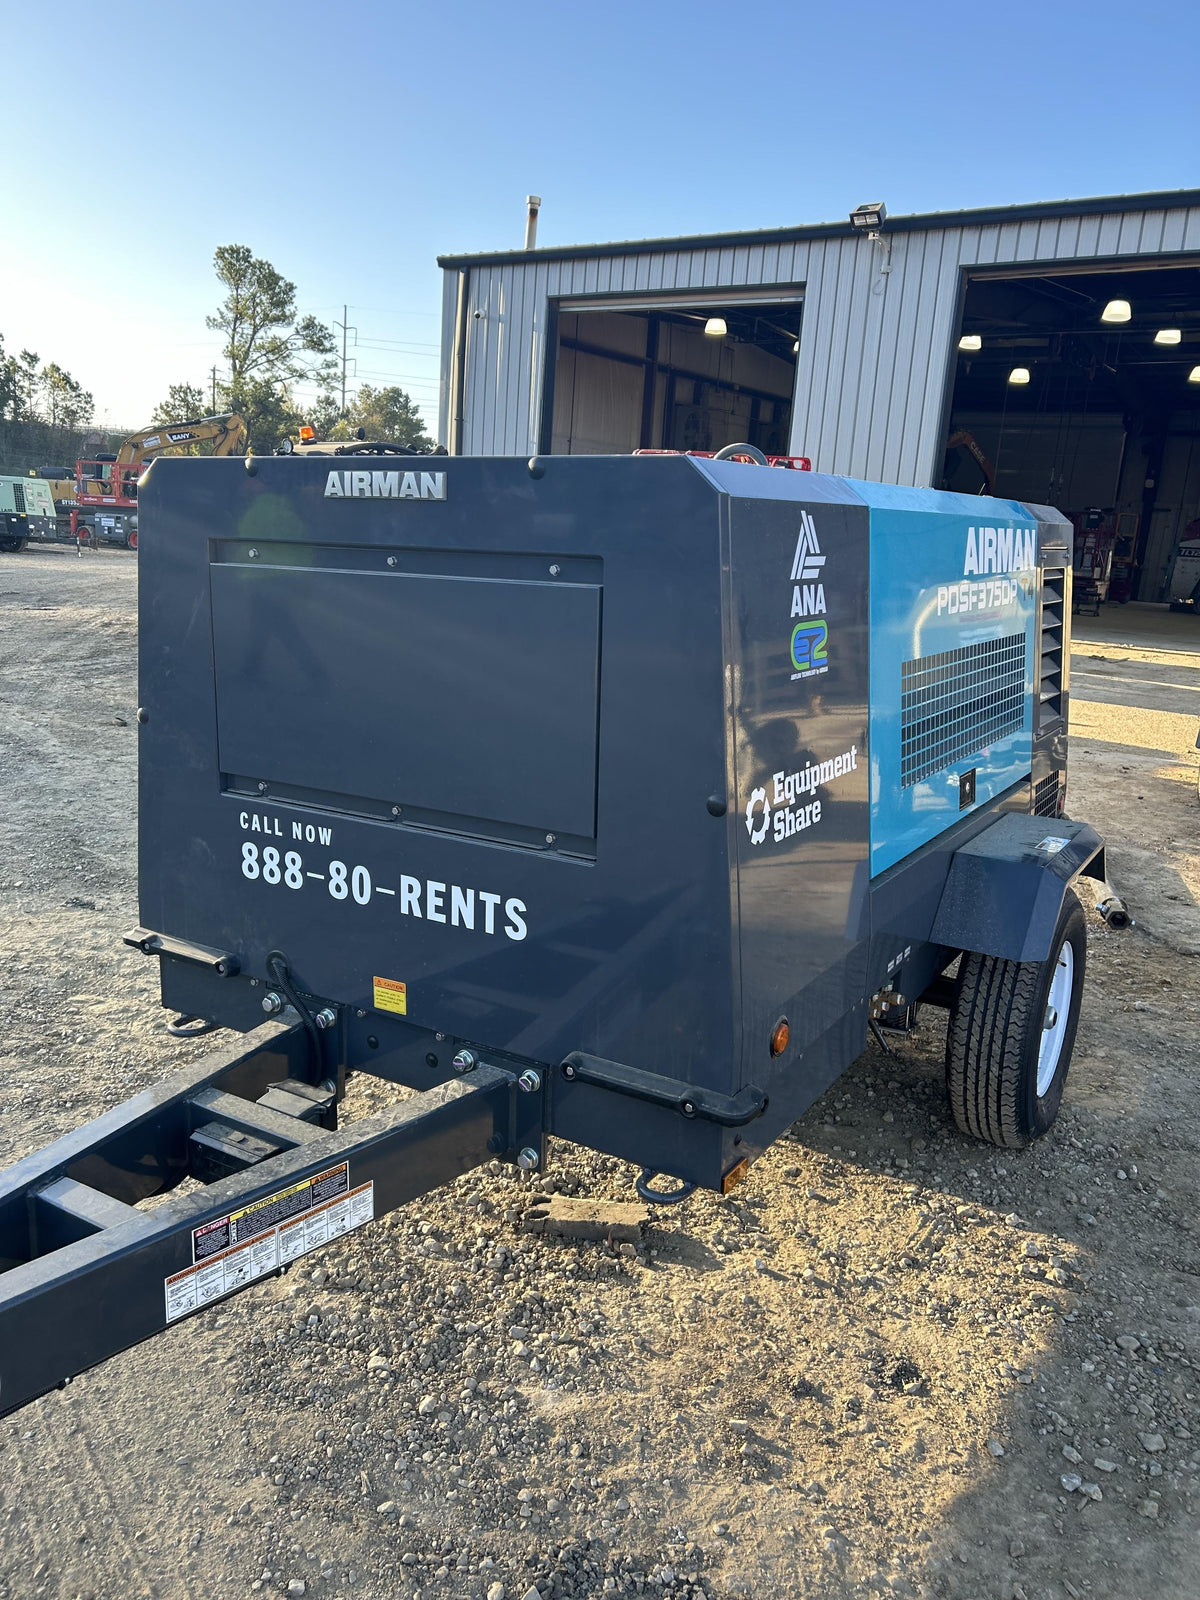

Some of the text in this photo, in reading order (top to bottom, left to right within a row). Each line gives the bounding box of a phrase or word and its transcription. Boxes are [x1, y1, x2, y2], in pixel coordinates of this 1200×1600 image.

[172, 433, 190, 441] SANY
[324, 471, 447, 500] AIRMAN
[963, 526, 1037, 576] AIRMAN
[790, 583, 827, 618] ANA
[773, 745, 858, 806] Equipment
[239, 811, 333, 847] CALL NOW
[773, 800, 822, 843] Share
[241, 841, 528, 942] 888-80-RENTS
[249, 1197, 274, 1212] CAUTION
[202, 1218, 228, 1233] DANGER
